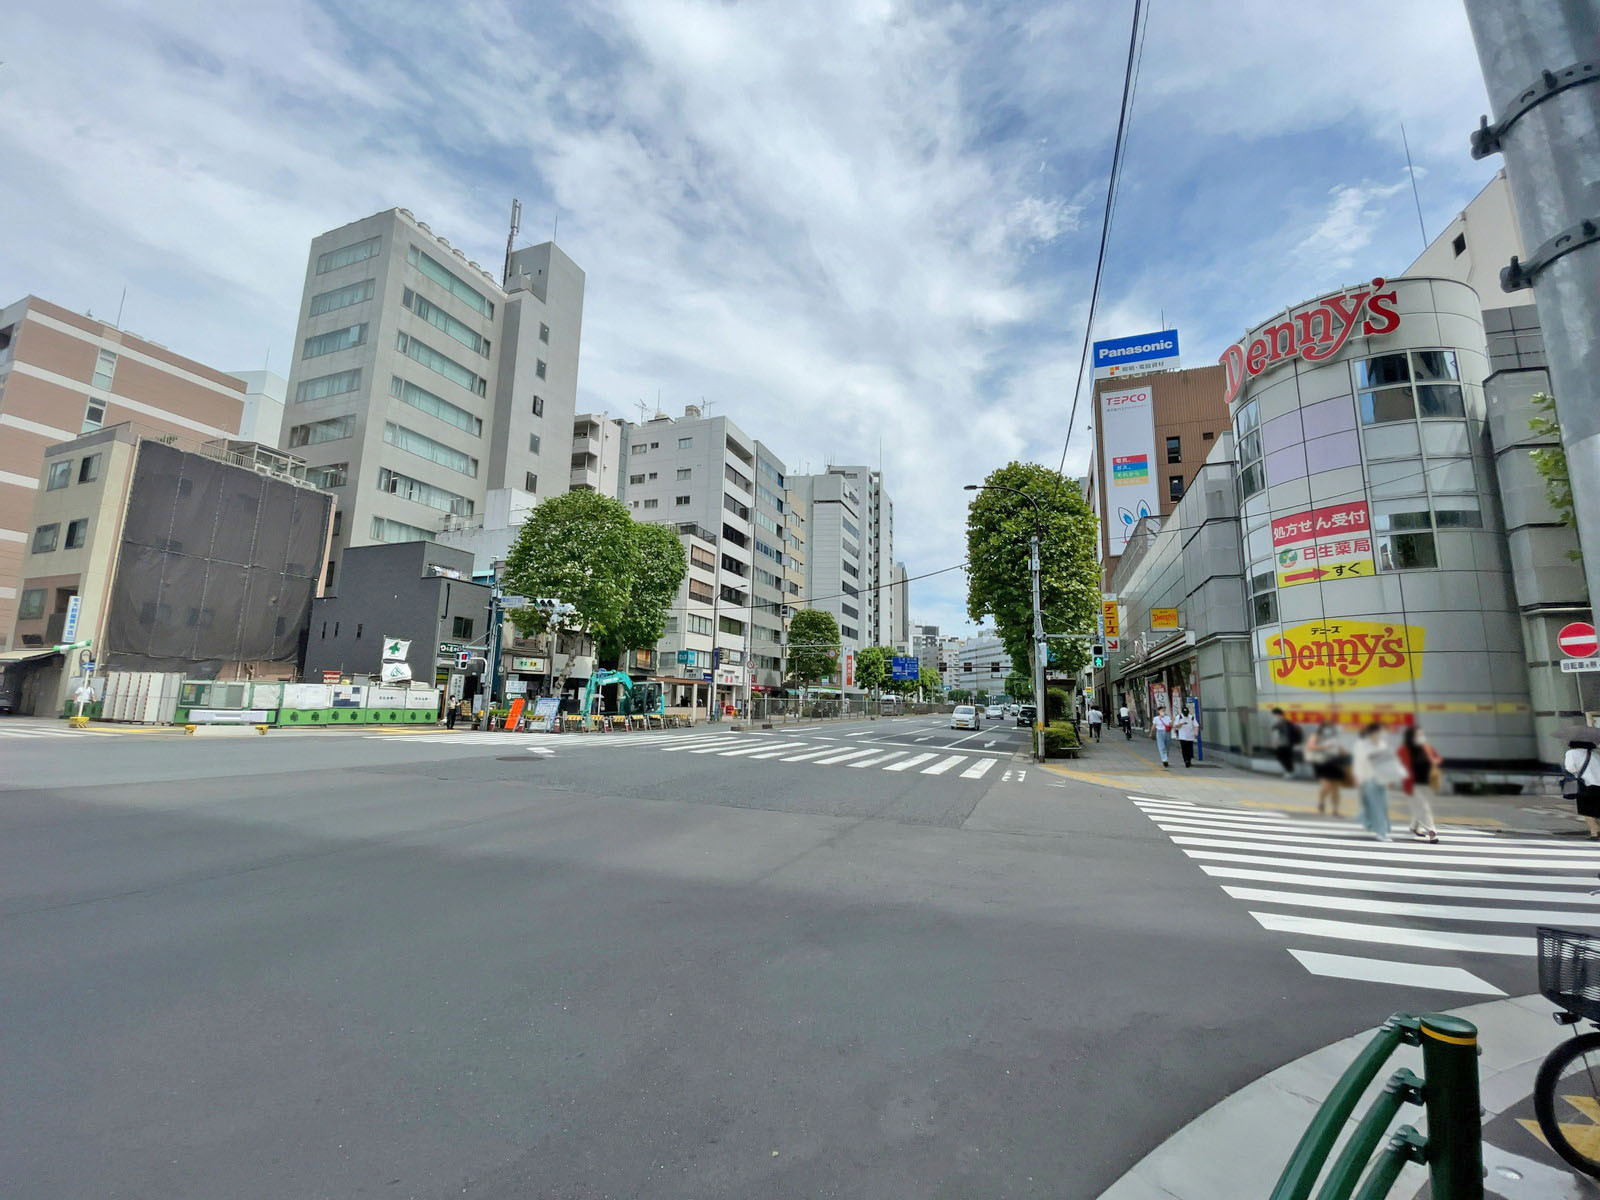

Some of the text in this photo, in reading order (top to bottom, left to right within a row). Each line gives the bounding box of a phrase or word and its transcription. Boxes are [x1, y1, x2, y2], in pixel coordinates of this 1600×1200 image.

[1099, 339, 1173, 359] Panasonic
[1218, 277, 1400, 404] Denny's
[1106, 393, 1147, 406] TEPCO
[1273, 509, 1367, 540] 処方せん受付
[1303, 538, 1371, 562] 日生薬局
[1332, 561, 1361, 577] すぐ
[1104, 603, 1118, 634] デニーズ
[1311, 625, 1342, 636] デニーズ
[1273, 627, 1405, 678] Denny's
[1563, 661, 1600, 671] 自転車を除
